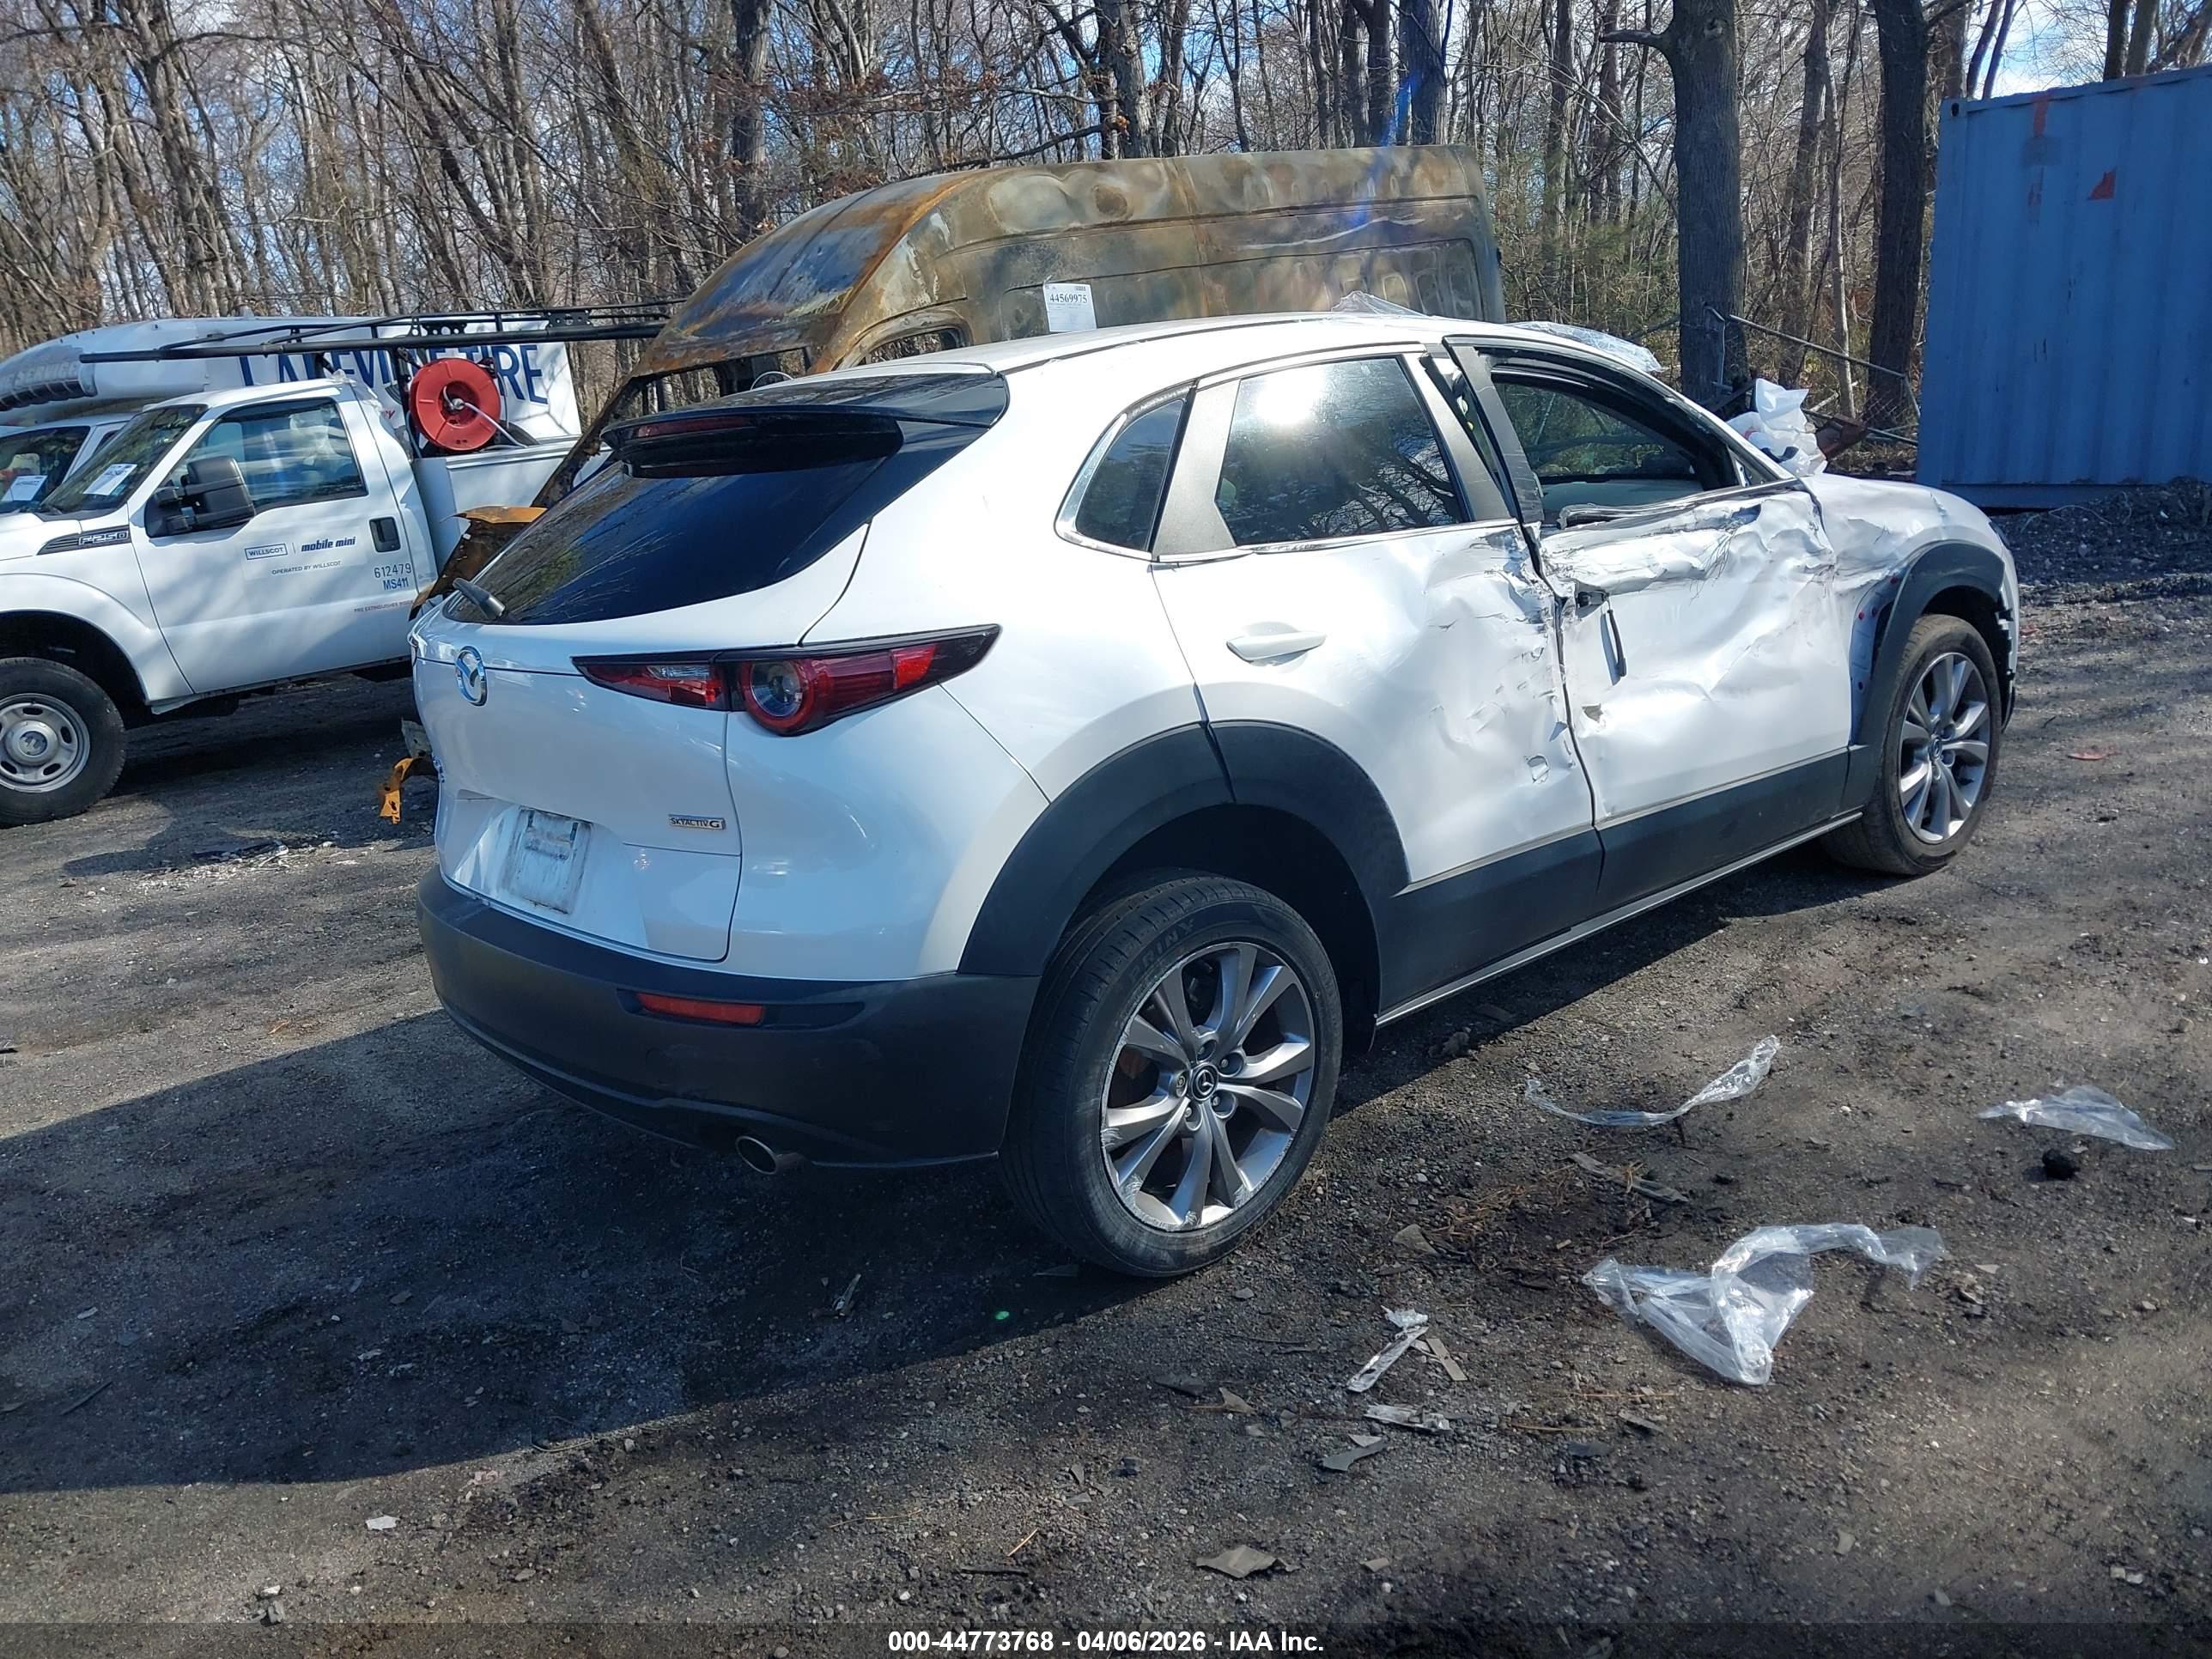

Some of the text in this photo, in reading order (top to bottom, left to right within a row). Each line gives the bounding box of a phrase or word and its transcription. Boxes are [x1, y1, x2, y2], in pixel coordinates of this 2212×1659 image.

[1049, 294, 1088, 303] 44569975
[248, 536, 356, 556] WILLSCOT mobile mini
[271, 566, 302, 575] OPERATED
[313, 561, 342, 569] WILLSCOT
[374, 562, 412, 579] 612479
[383, 577, 409, 591] MS411
